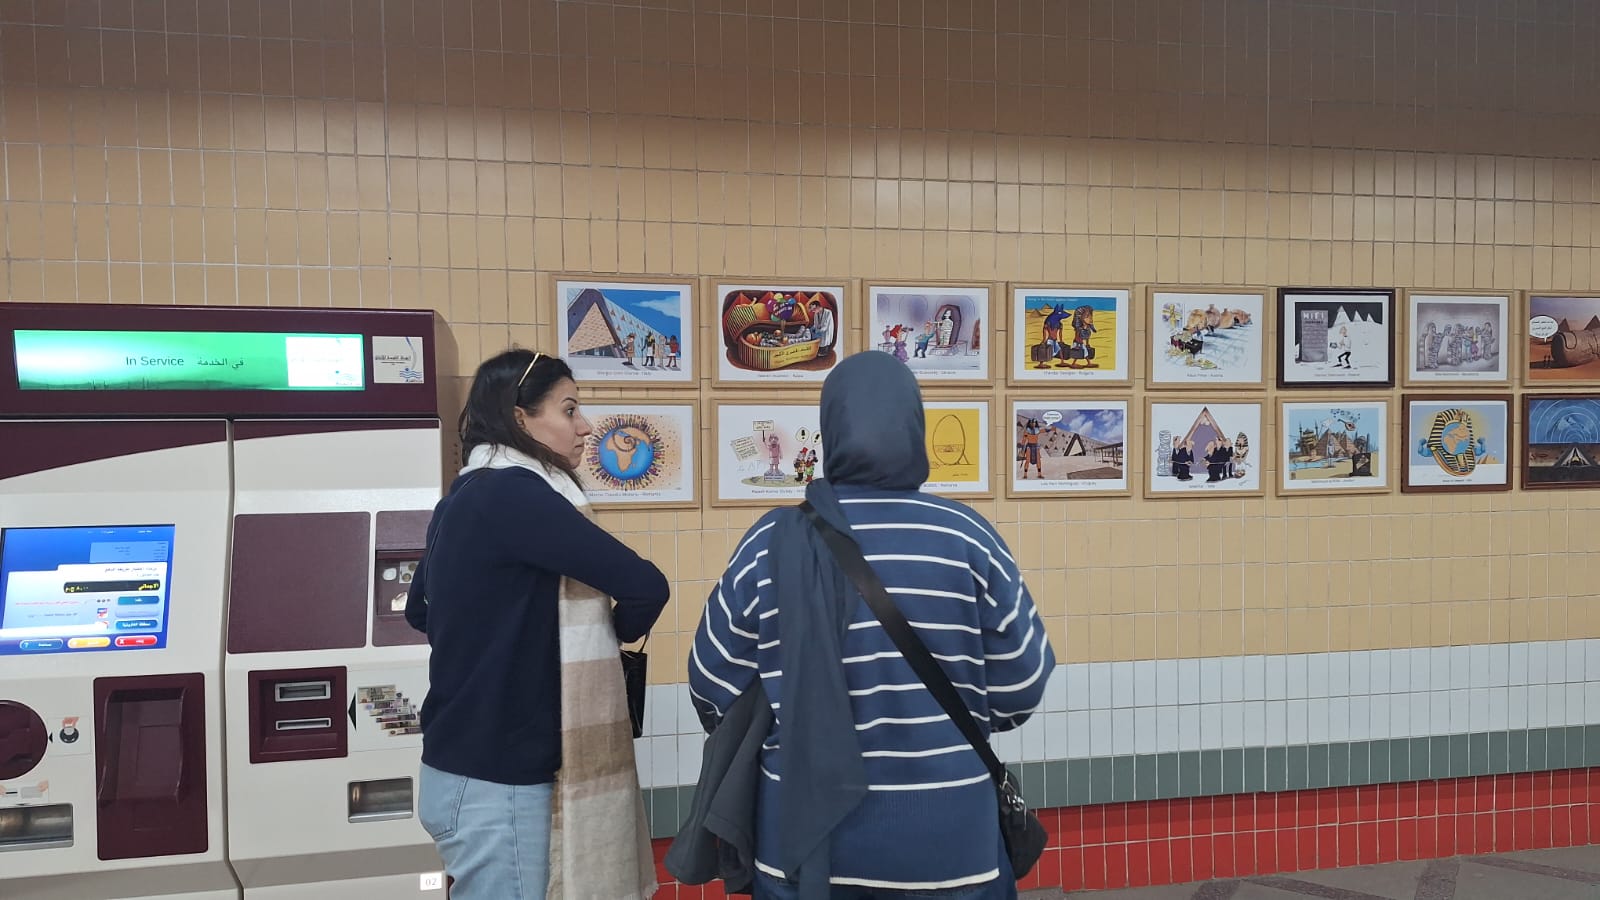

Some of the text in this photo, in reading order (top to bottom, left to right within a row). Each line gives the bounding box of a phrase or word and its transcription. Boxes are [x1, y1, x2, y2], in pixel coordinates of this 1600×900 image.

[126, 356, 185, 366] In Service
[197, 356, 244, 369] في الخدمة
[426, 877, 437, 886] 02
